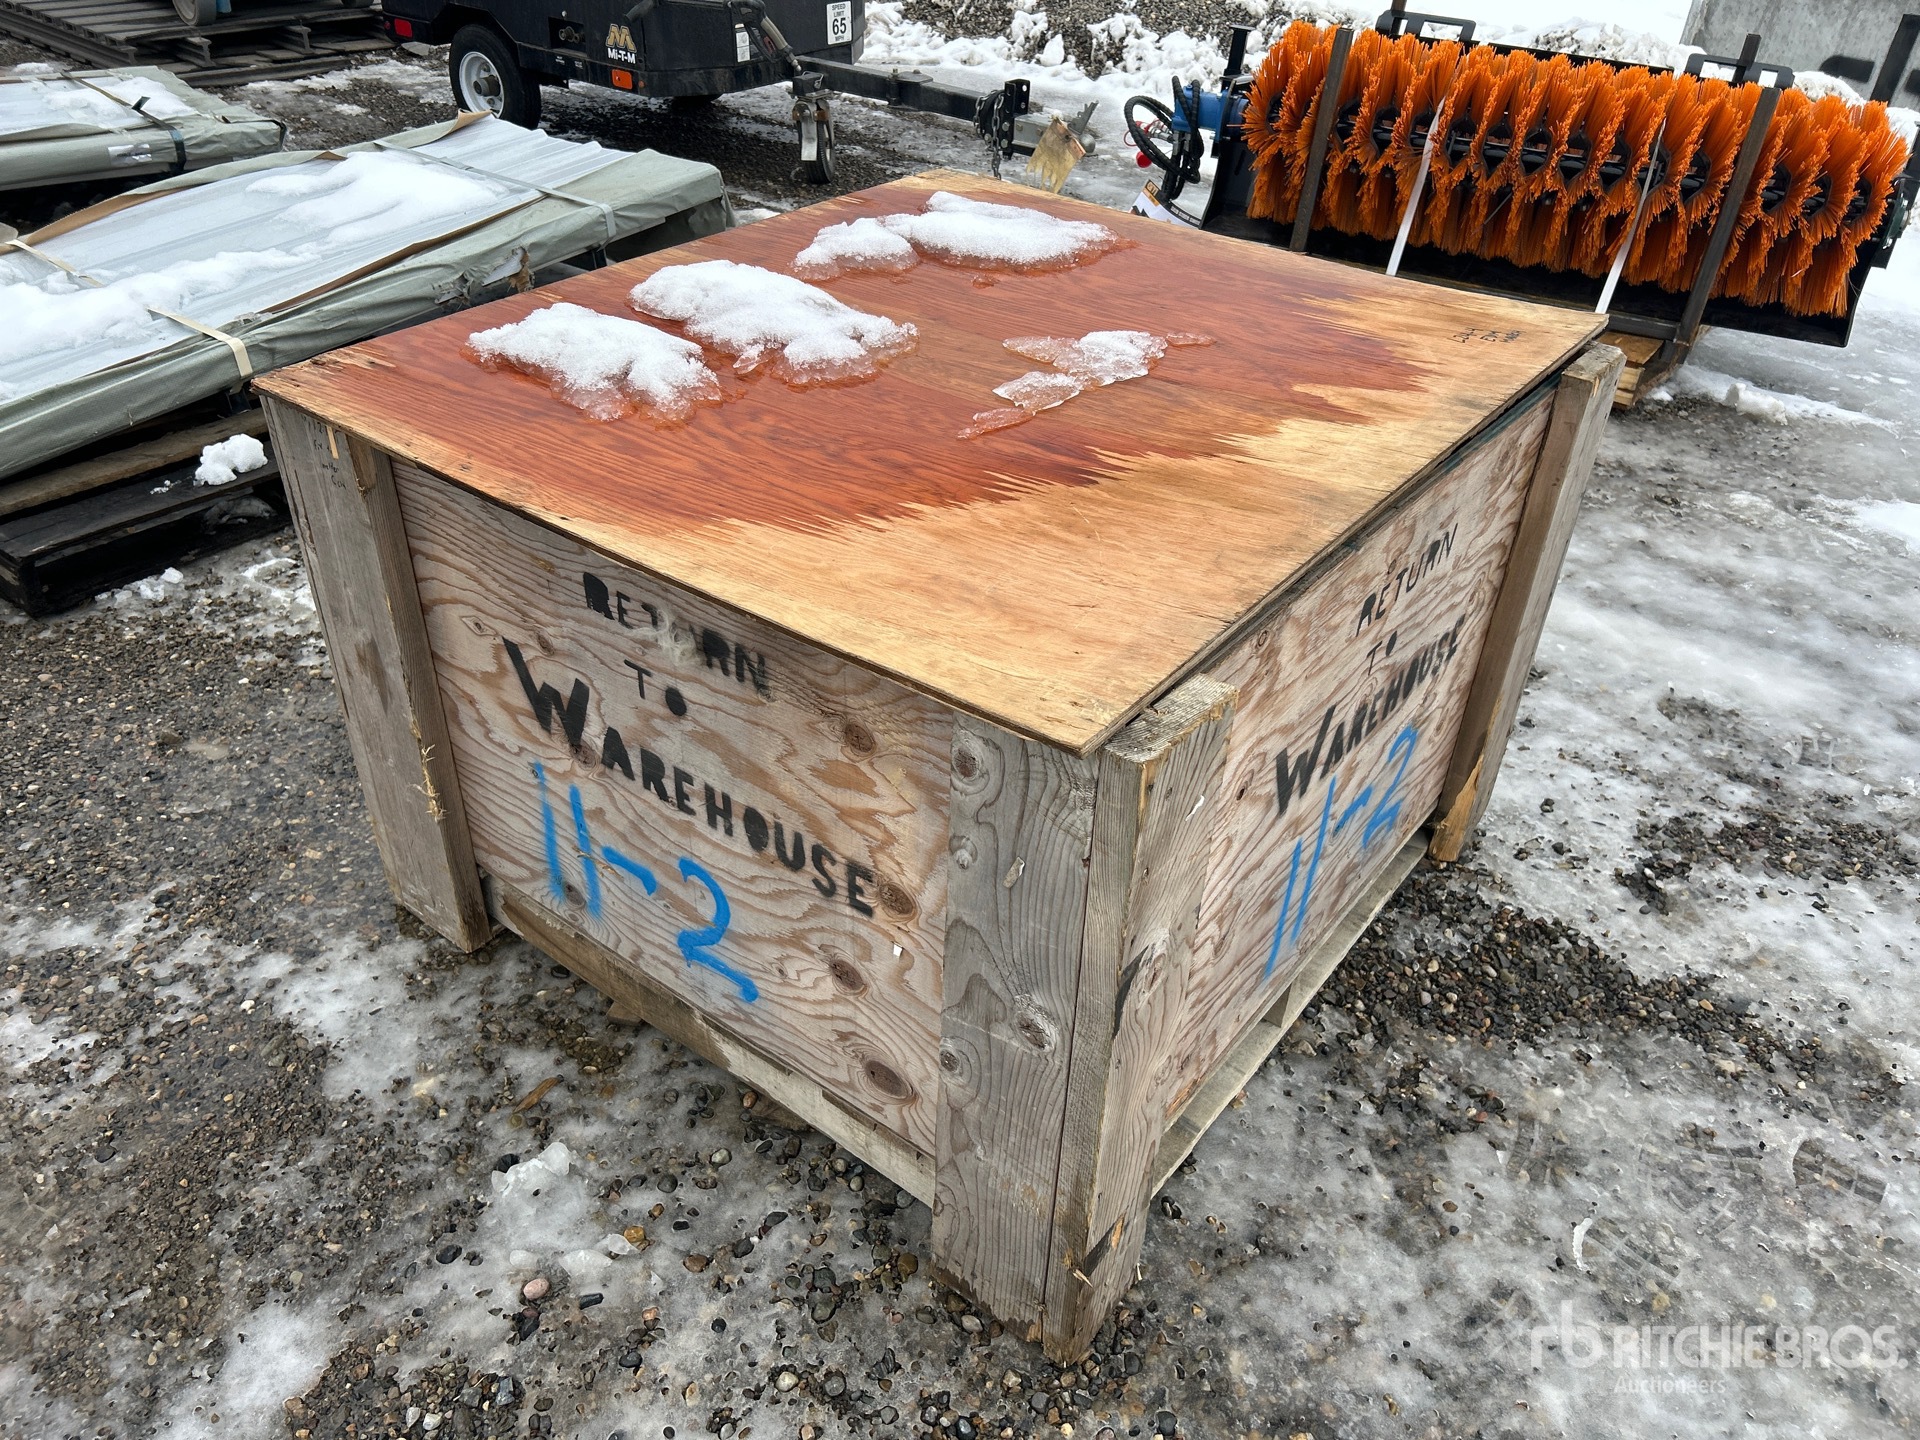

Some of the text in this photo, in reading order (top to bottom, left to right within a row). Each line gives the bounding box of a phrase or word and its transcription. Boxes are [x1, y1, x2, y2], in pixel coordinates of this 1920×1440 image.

[832, 17, 847, 35] 65
[607, 48, 636, 64] Mi-T-M
[1356, 523, 1459, 638] RETURN
[1366, 630, 1398, 676] TO
[624, 659, 688, 717] TO
[1274, 613, 1467, 816] WAREHOUSE
[502, 635, 875, 918] WAREHOUSE
